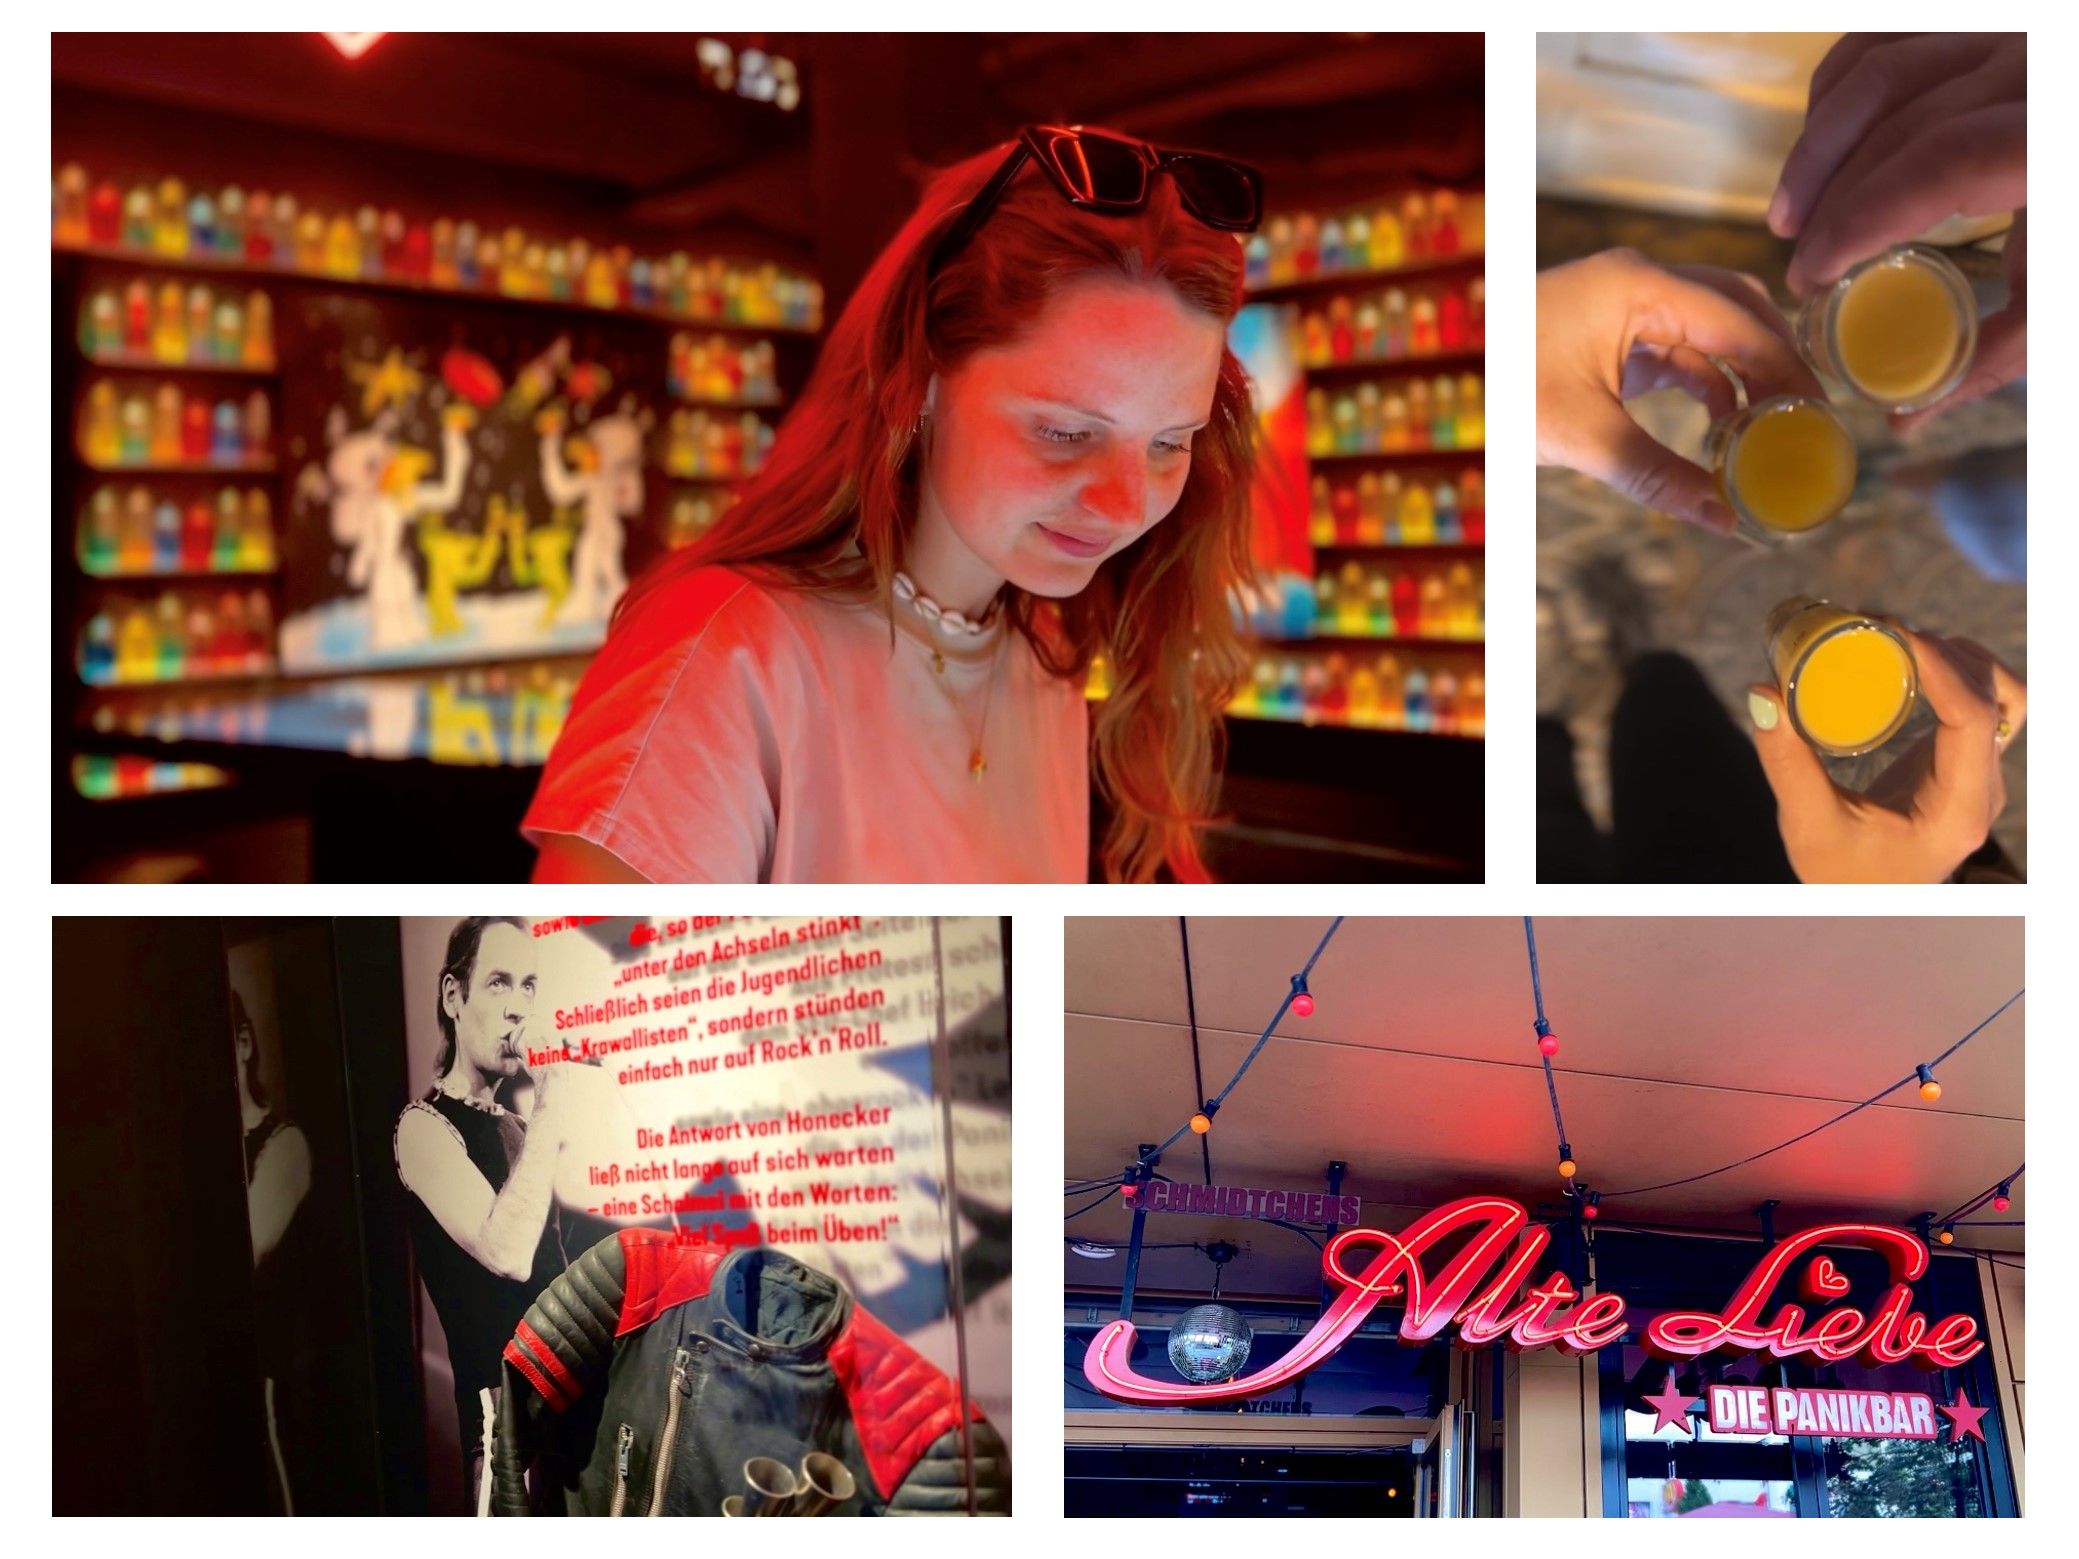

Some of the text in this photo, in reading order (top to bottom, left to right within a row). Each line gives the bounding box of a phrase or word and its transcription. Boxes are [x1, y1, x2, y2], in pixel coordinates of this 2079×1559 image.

[666, 919, 688, 938] so
[673, 949, 706, 972] den
[712, 926, 790, 964] Achseln
[555, 993, 648, 1031] Schließlich
[653, 986, 702, 1011] seien
[707, 977, 735, 1000] die
[741, 948, 882, 996] Jugendlichen
[707, 1005, 788, 1036] sondern
[794, 986, 885, 1020] stünden
[618, 1056, 683, 1085] einfach
[688, 1055, 718, 1074] nur
[724, 1042, 755, 1070] auf
[637, 1128, 664, 1149] Die
[669, 1121, 741, 1147] Antwort
[746, 1119, 781, 1138] von
[787, 1103, 892, 1133] Honecker
[589, 1145, 895, 1187] ließ nicht lange auf sich warten
[603, 1197, 637, 1217] eine
[768, 1184, 805, 1208] den
[809, 1181, 899, 1206] Worten:
[1125, 1180, 1361, 1225] SCHMIDTCHENS
[767, 1221, 818, 1244] beim
[1083, 1197, 1986, 1402] Alte Liebe
[1713, 1388, 1935, 1435] DIE PANIKBAR
